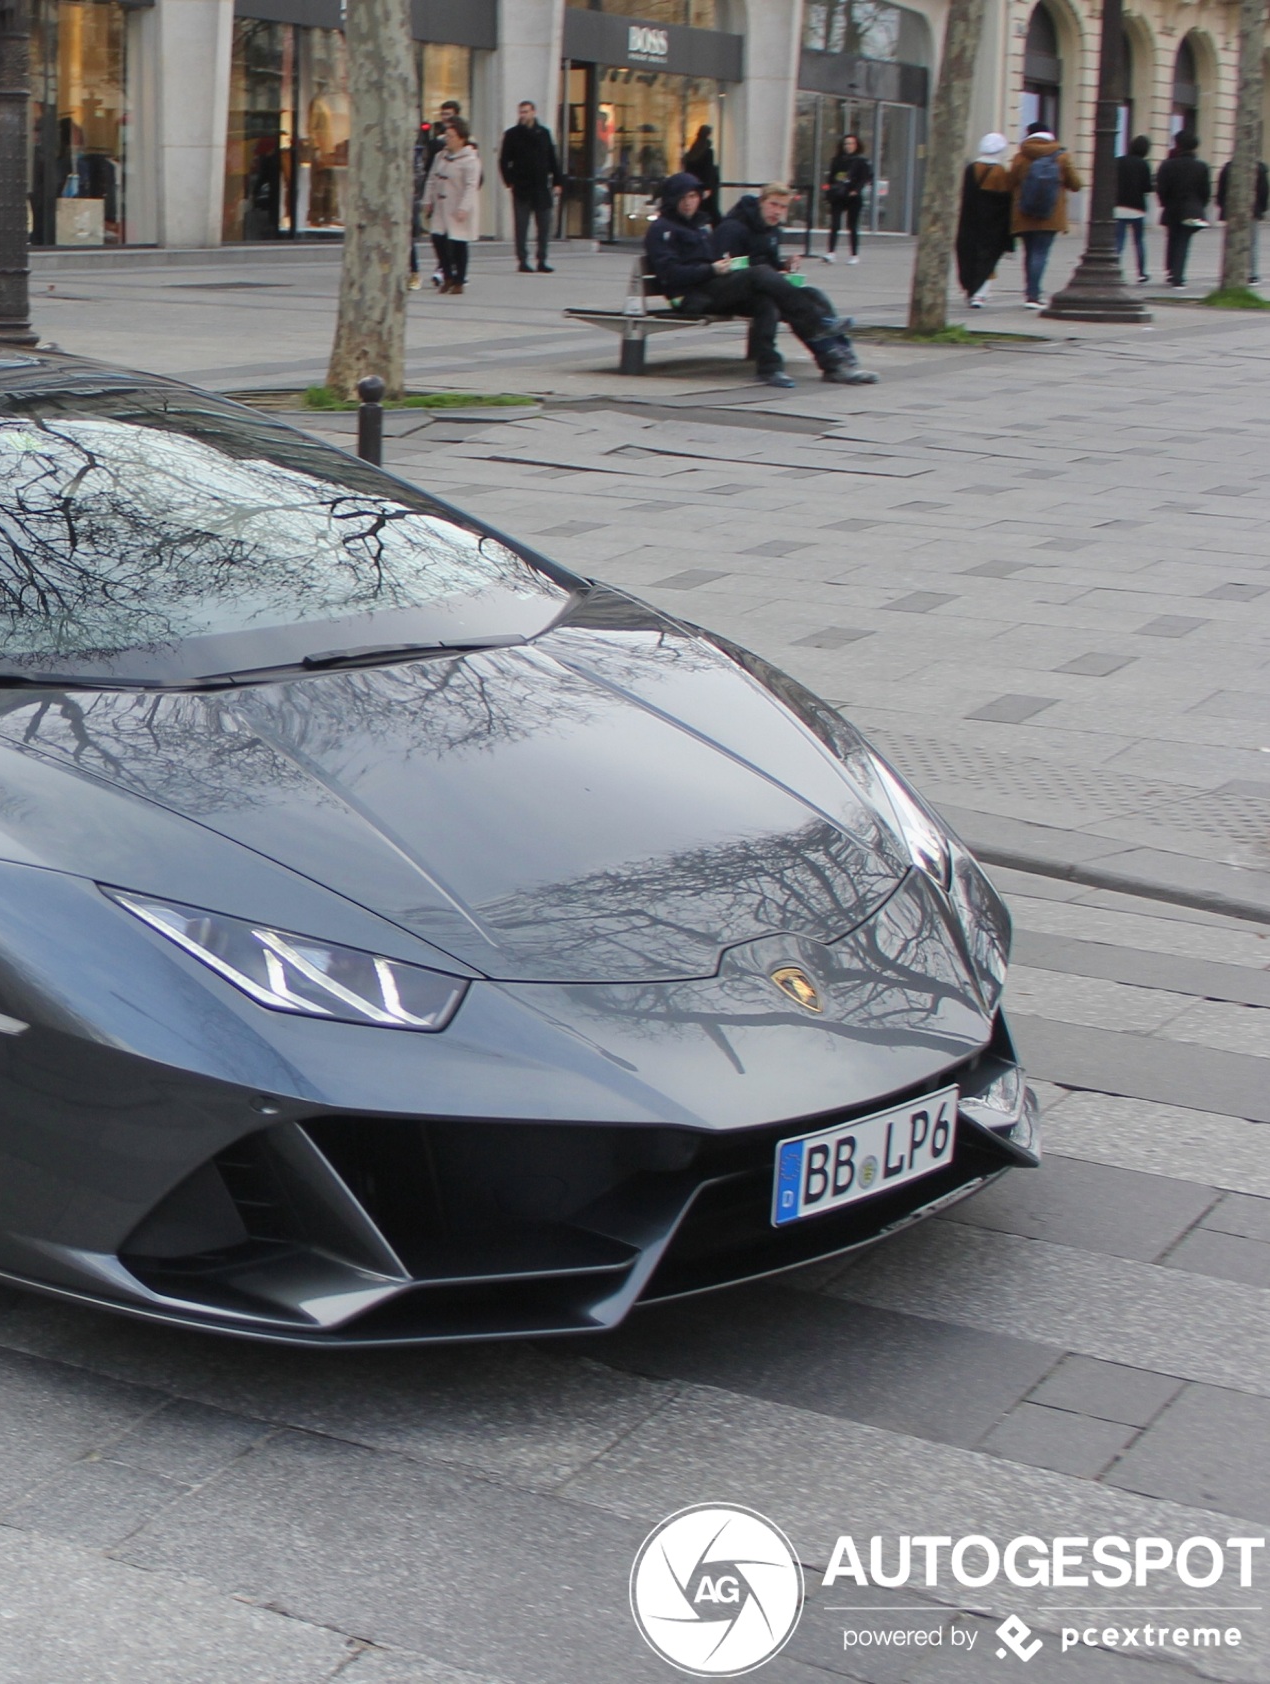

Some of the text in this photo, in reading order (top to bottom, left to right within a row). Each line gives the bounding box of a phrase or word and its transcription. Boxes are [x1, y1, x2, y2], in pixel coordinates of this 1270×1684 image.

[628, 26, 669, 55] BOSS
[803, 1101, 949, 1206] BB LP6
